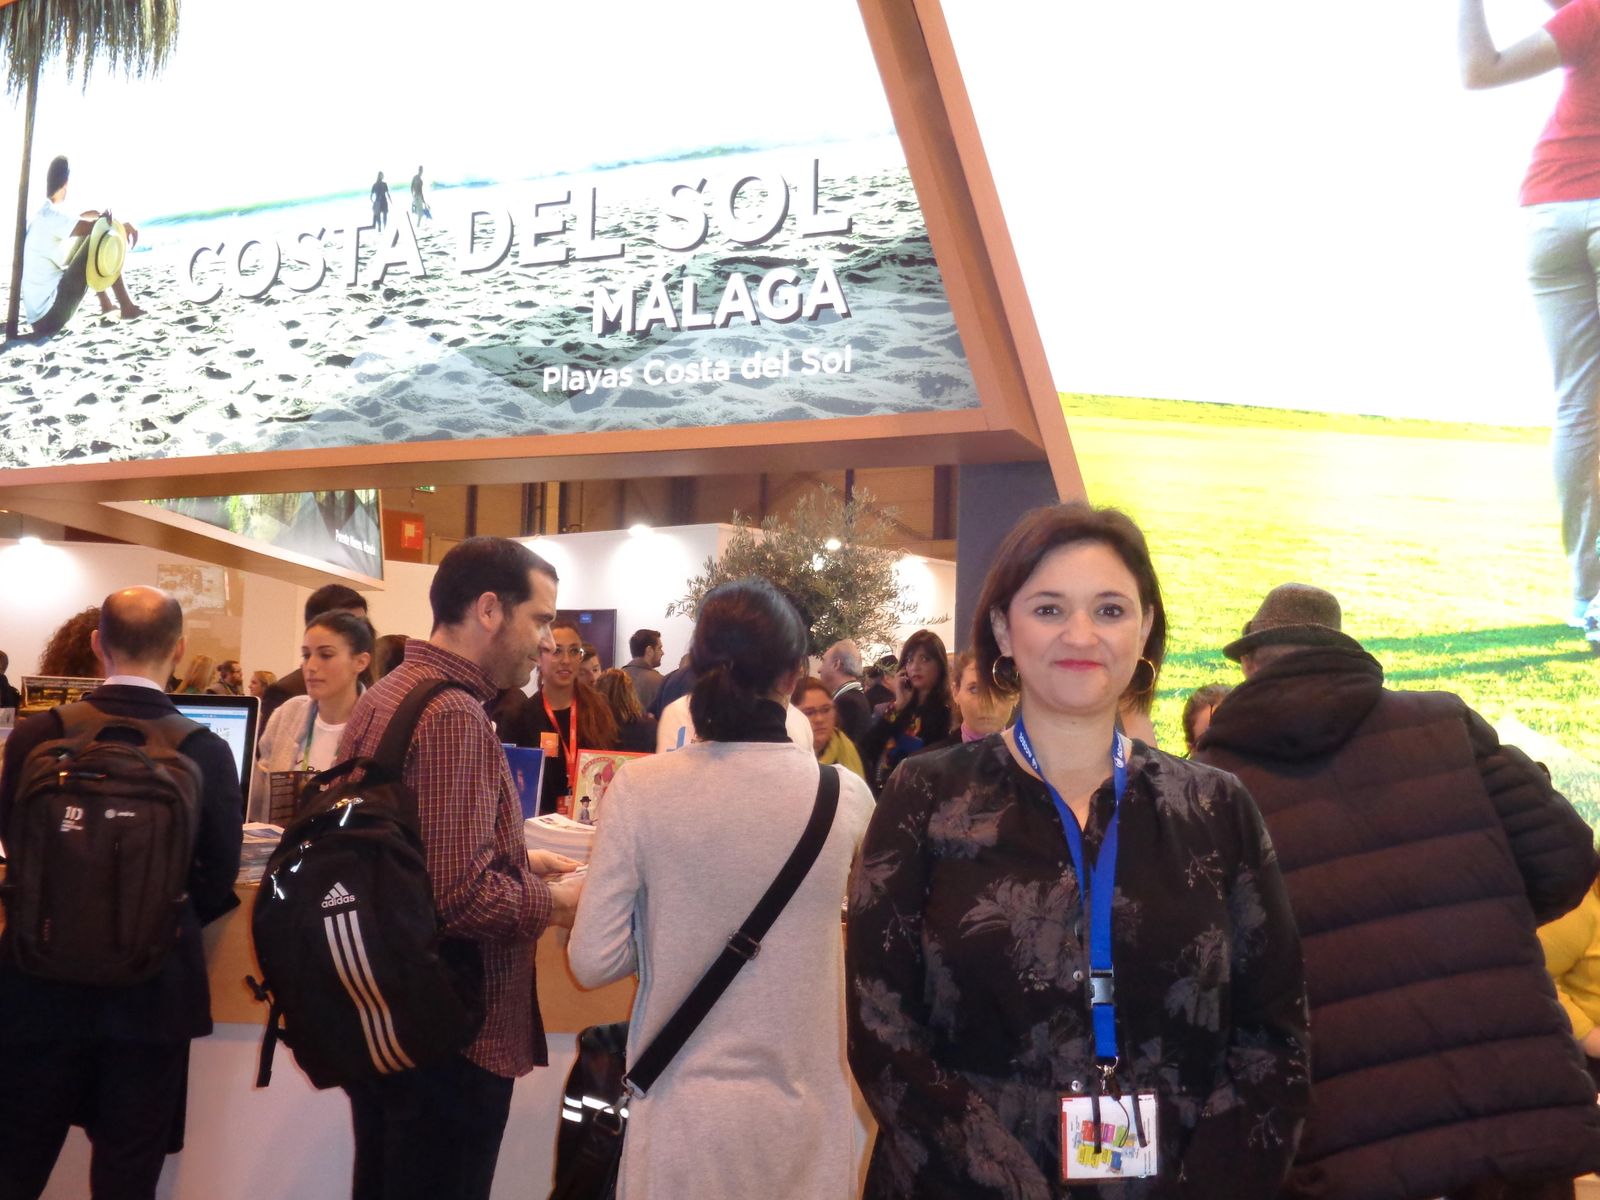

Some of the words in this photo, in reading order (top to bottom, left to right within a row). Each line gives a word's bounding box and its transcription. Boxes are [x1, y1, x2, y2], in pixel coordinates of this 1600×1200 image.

[181, 208, 427, 305] COSTA
[455, 184, 625, 275] DEL
[654, 158, 853, 253] SOL
[591, 255, 852, 338] MÁLAGA
[542, 364, 633, 394] Playas
[643, 359, 730, 386] Costa
[741, 349, 789, 380] del
[801, 344, 851, 375] Sol
[321, 894, 355, 908] adidas
